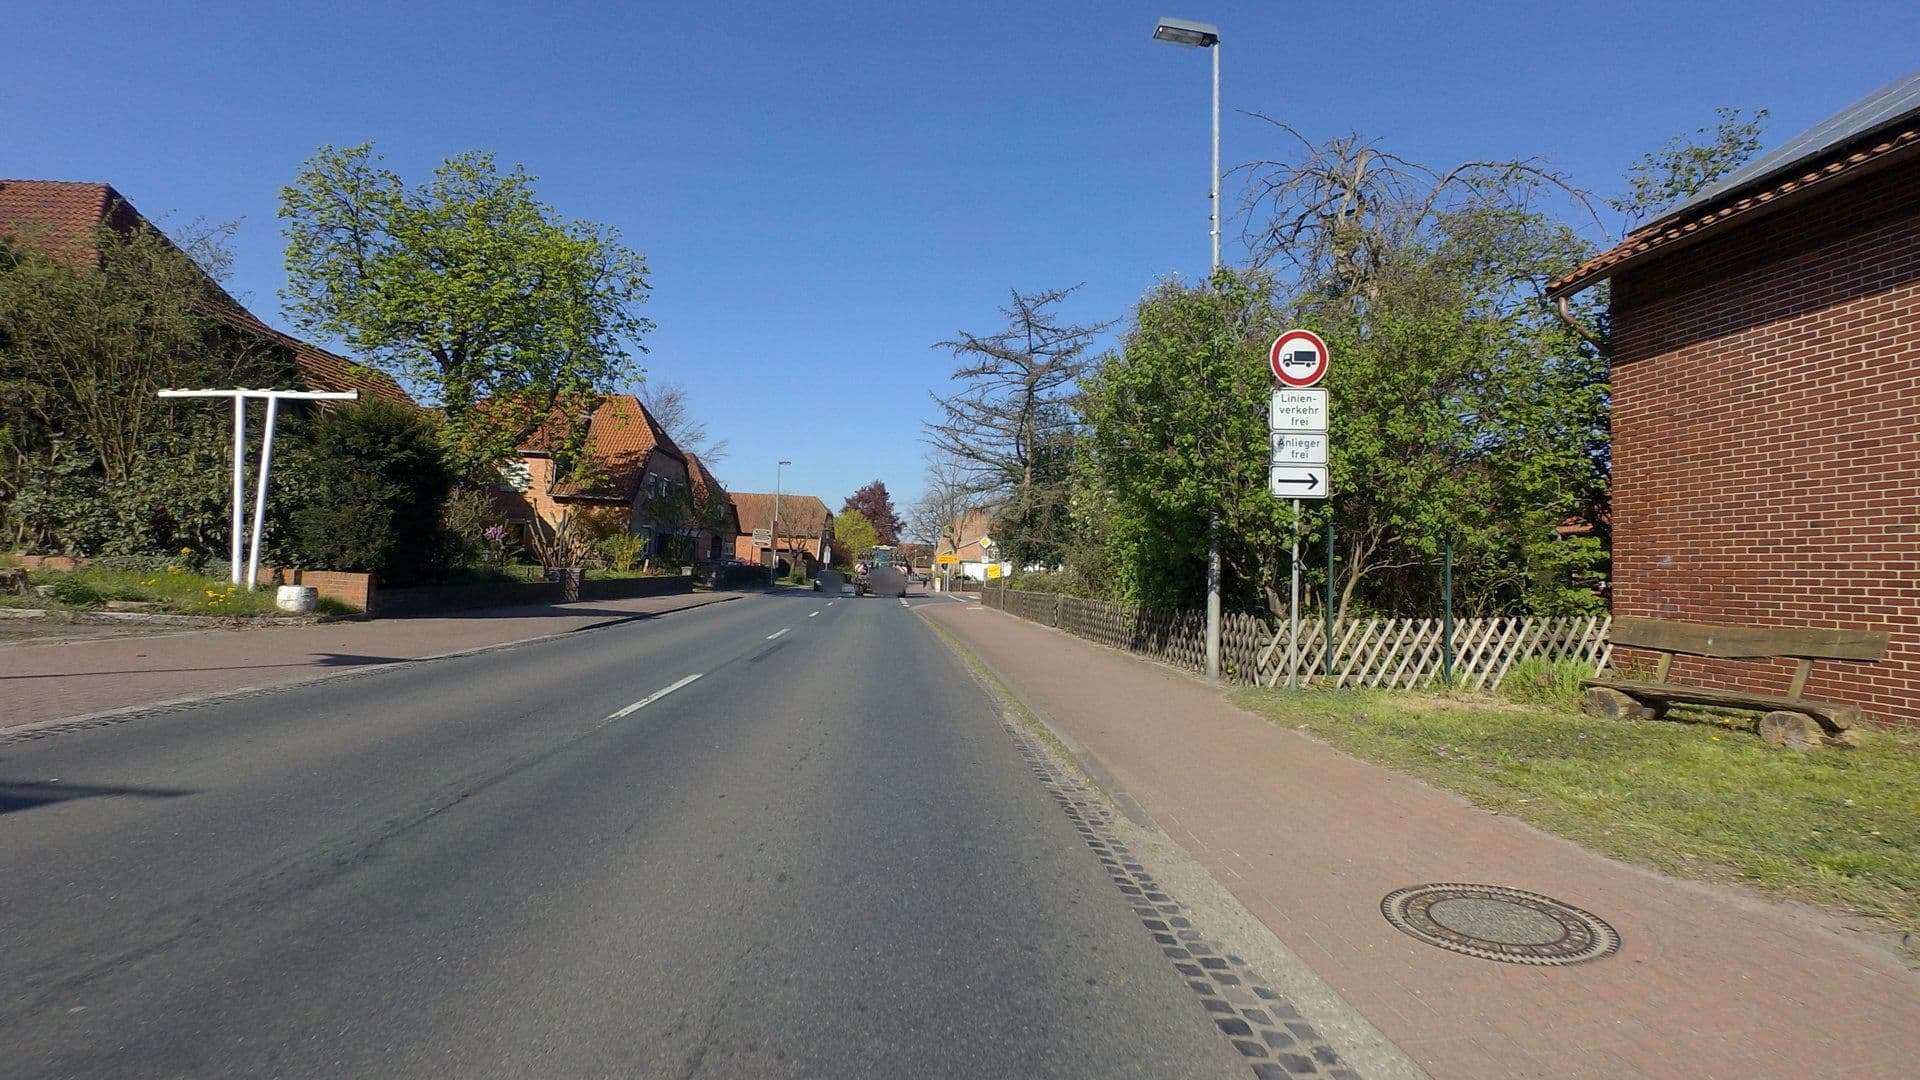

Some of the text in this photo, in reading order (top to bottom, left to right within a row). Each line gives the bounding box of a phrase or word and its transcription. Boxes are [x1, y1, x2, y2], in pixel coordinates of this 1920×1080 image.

[1281, 393, 1317, 403] Linien-
[1279, 406, 1320, 415] verkehr
[1291, 417, 1309, 426] frei
[1279, 438, 1320, 449] Anlieger
[1291, 450, 1309, 459] frei
